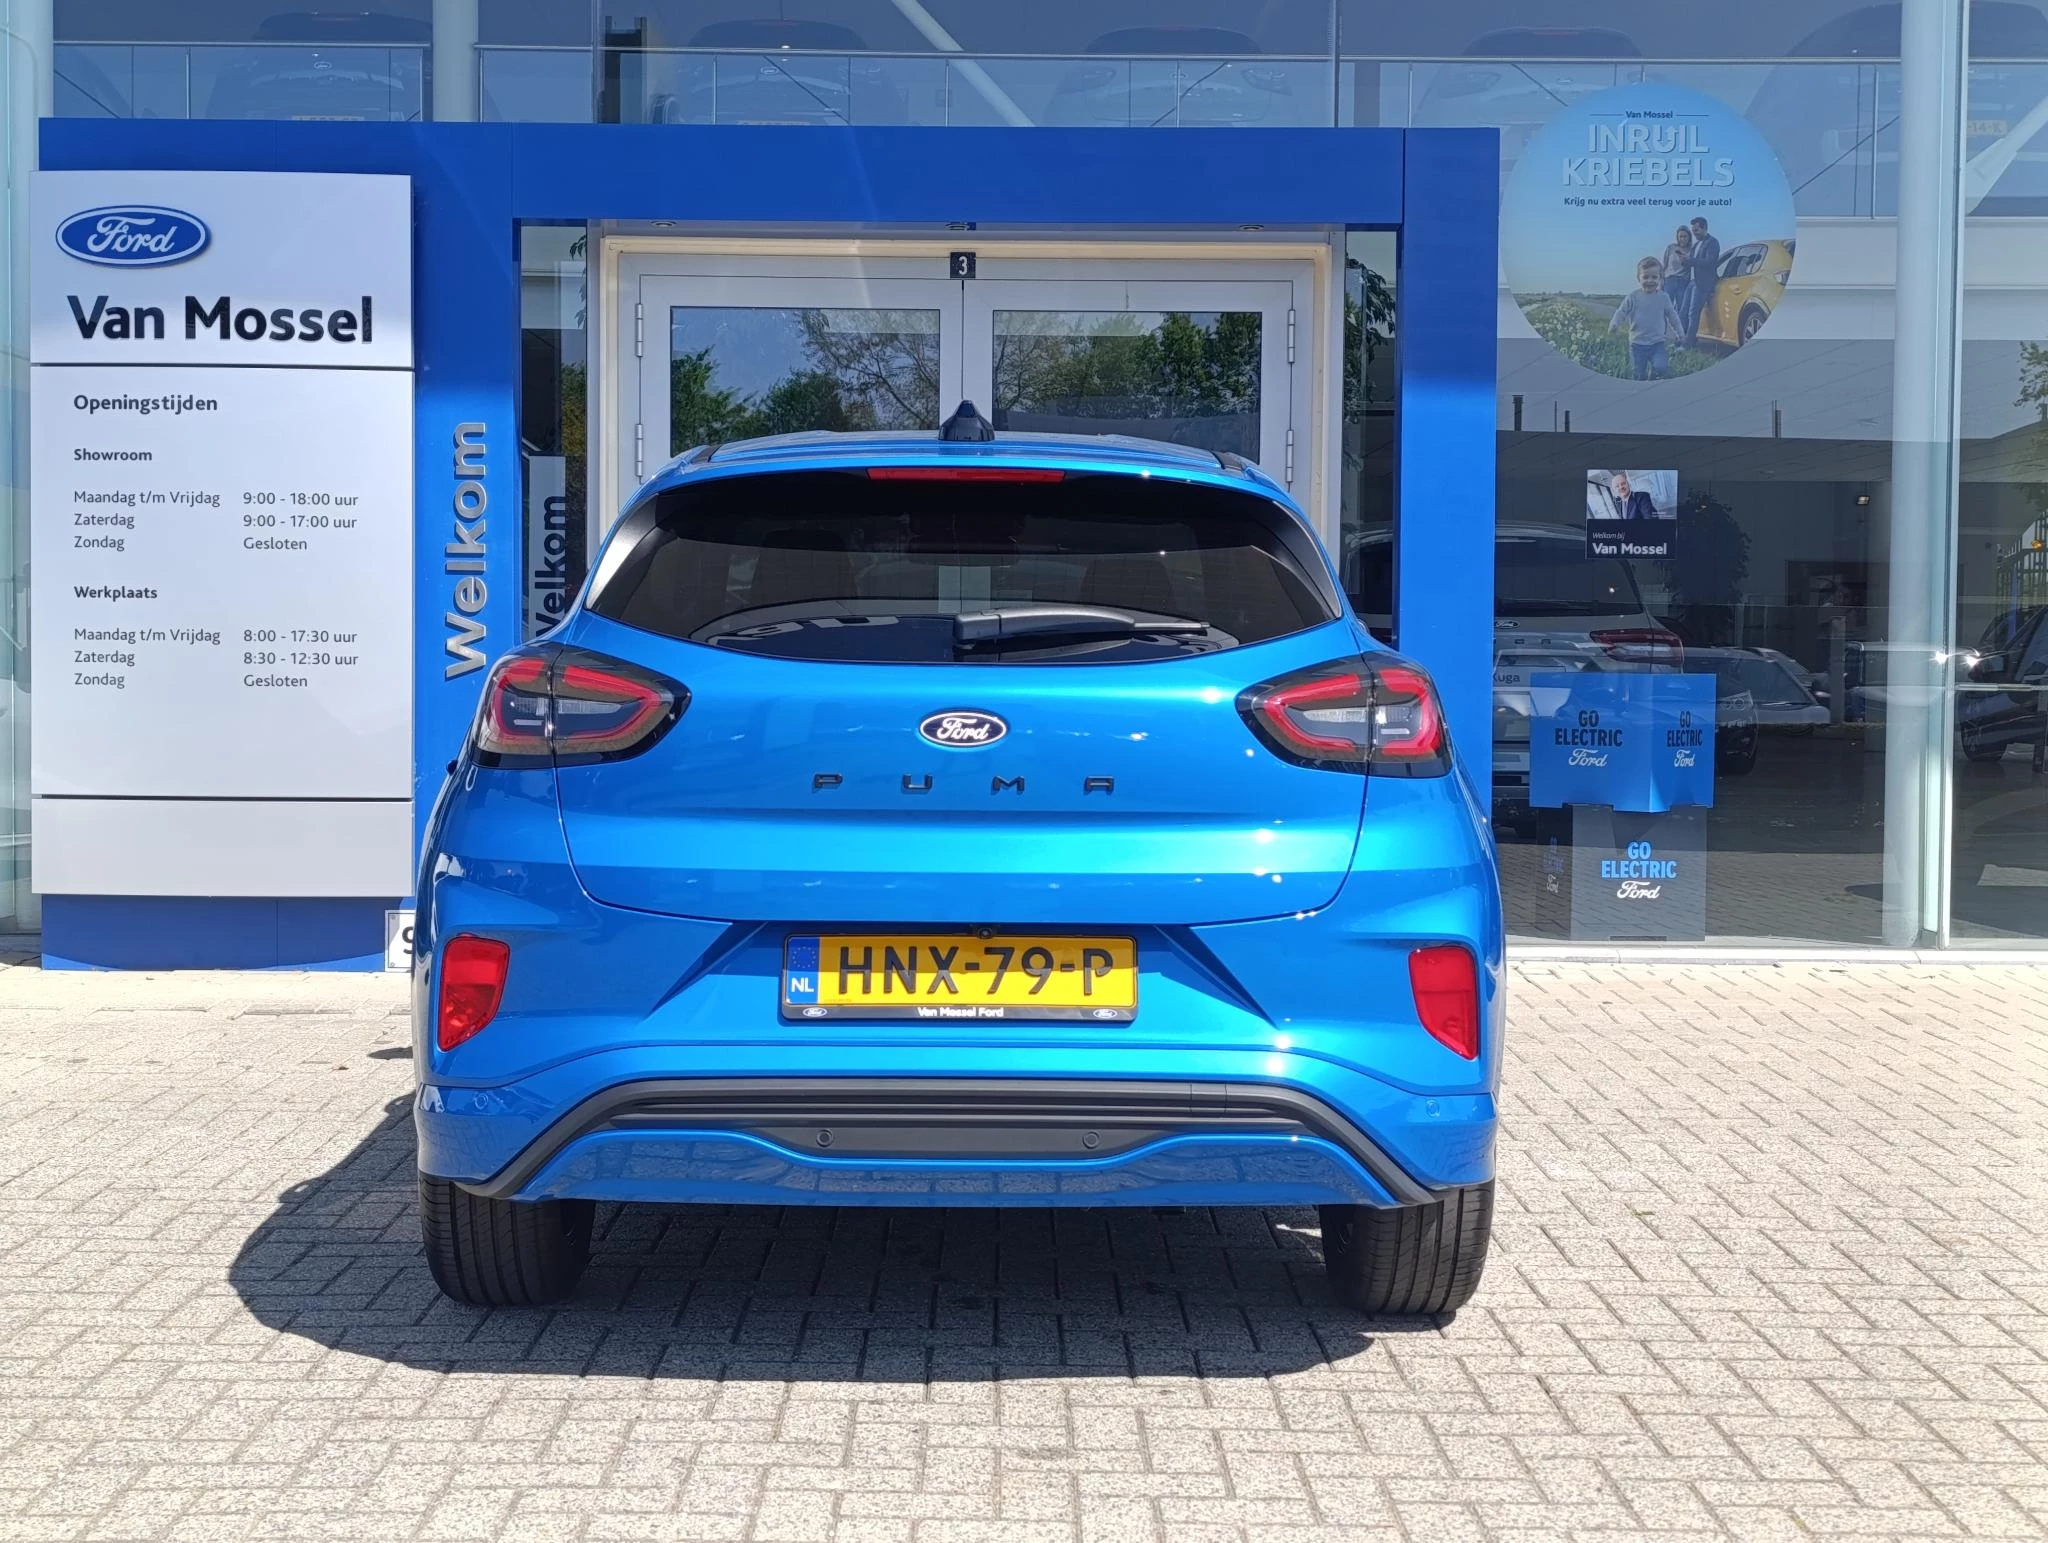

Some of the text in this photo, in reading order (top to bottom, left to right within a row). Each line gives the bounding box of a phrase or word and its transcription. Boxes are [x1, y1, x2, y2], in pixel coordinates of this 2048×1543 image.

[1625, 110, 1674, 119] Van Mossel
[1589, 122, 1711, 153] INRUIL
[1563, 158, 1736, 187] KRIEBELS
[1563, 196, 1732, 208] Krijg nu extra veel terug voor je auto!
[86, 215, 178, 253] Ford
[958, 255, 969, 276] 3
[67, 295, 373, 343] Van Mossel
[74, 394, 218, 415] Openingstijden
[74, 447, 153, 461] Showroom
[74, 490, 136, 507] Maandag
[139, 490, 166, 504] t/m
[169, 491, 221, 508] Vrijdag
[243, 492, 276, 505] 9:00
[290, 492, 331, 506] 18:00
[335, 496, 359, 506] uur
[74, 513, 135, 530] Zaterdag
[243, 514, 276, 528] 9:00
[290, 515, 329, 528] 17:00
[333, 518, 358, 529] uur
[74, 535, 308, 553] Zondag Gesloten
[446, 422, 487, 679] Welkom
[1592, 542, 1667, 555] Van Mossel
[74, 585, 158, 602] Werkplaats
[74, 628, 136, 645] Maandag
[139, 628, 166, 641] t/m
[169, 628, 221, 646] Vrijdag
[243, 629, 276, 642] 8:00
[290, 630, 330, 643] 17:30
[333, 633, 358, 643] uur
[74, 650, 136, 667] Zaterdag
[243, 652, 276, 665] 8:30
[290, 652, 331, 666] 12:30
[335, 655, 359, 665] uur
[74, 672, 308, 689] Zondag Gesloten
[1578, 710, 1600, 728] GO
[1679, 711, 1692, 728] GO
[936, 717, 989, 740] Ford
[1555, 728, 1623, 747] ELECTRIC
[1667, 729, 1703, 747] ELECTRIC
[1568, 748, 1609, 767] Ford
[1673, 749, 1696, 767] Ford
[812, 773, 1115, 794] PUMA
[1627, 841, 1652, 860] GO
[1601, 860, 1677, 879] ELECTRIC
[1616, 880, 1662, 899] Ford
[838, 945, 1114, 997] HNX-79-P
[791, 977, 814, 993] NL
[918, 1007, 938, 1017] Van
[978, 1007, 1005, 1017] Ford
